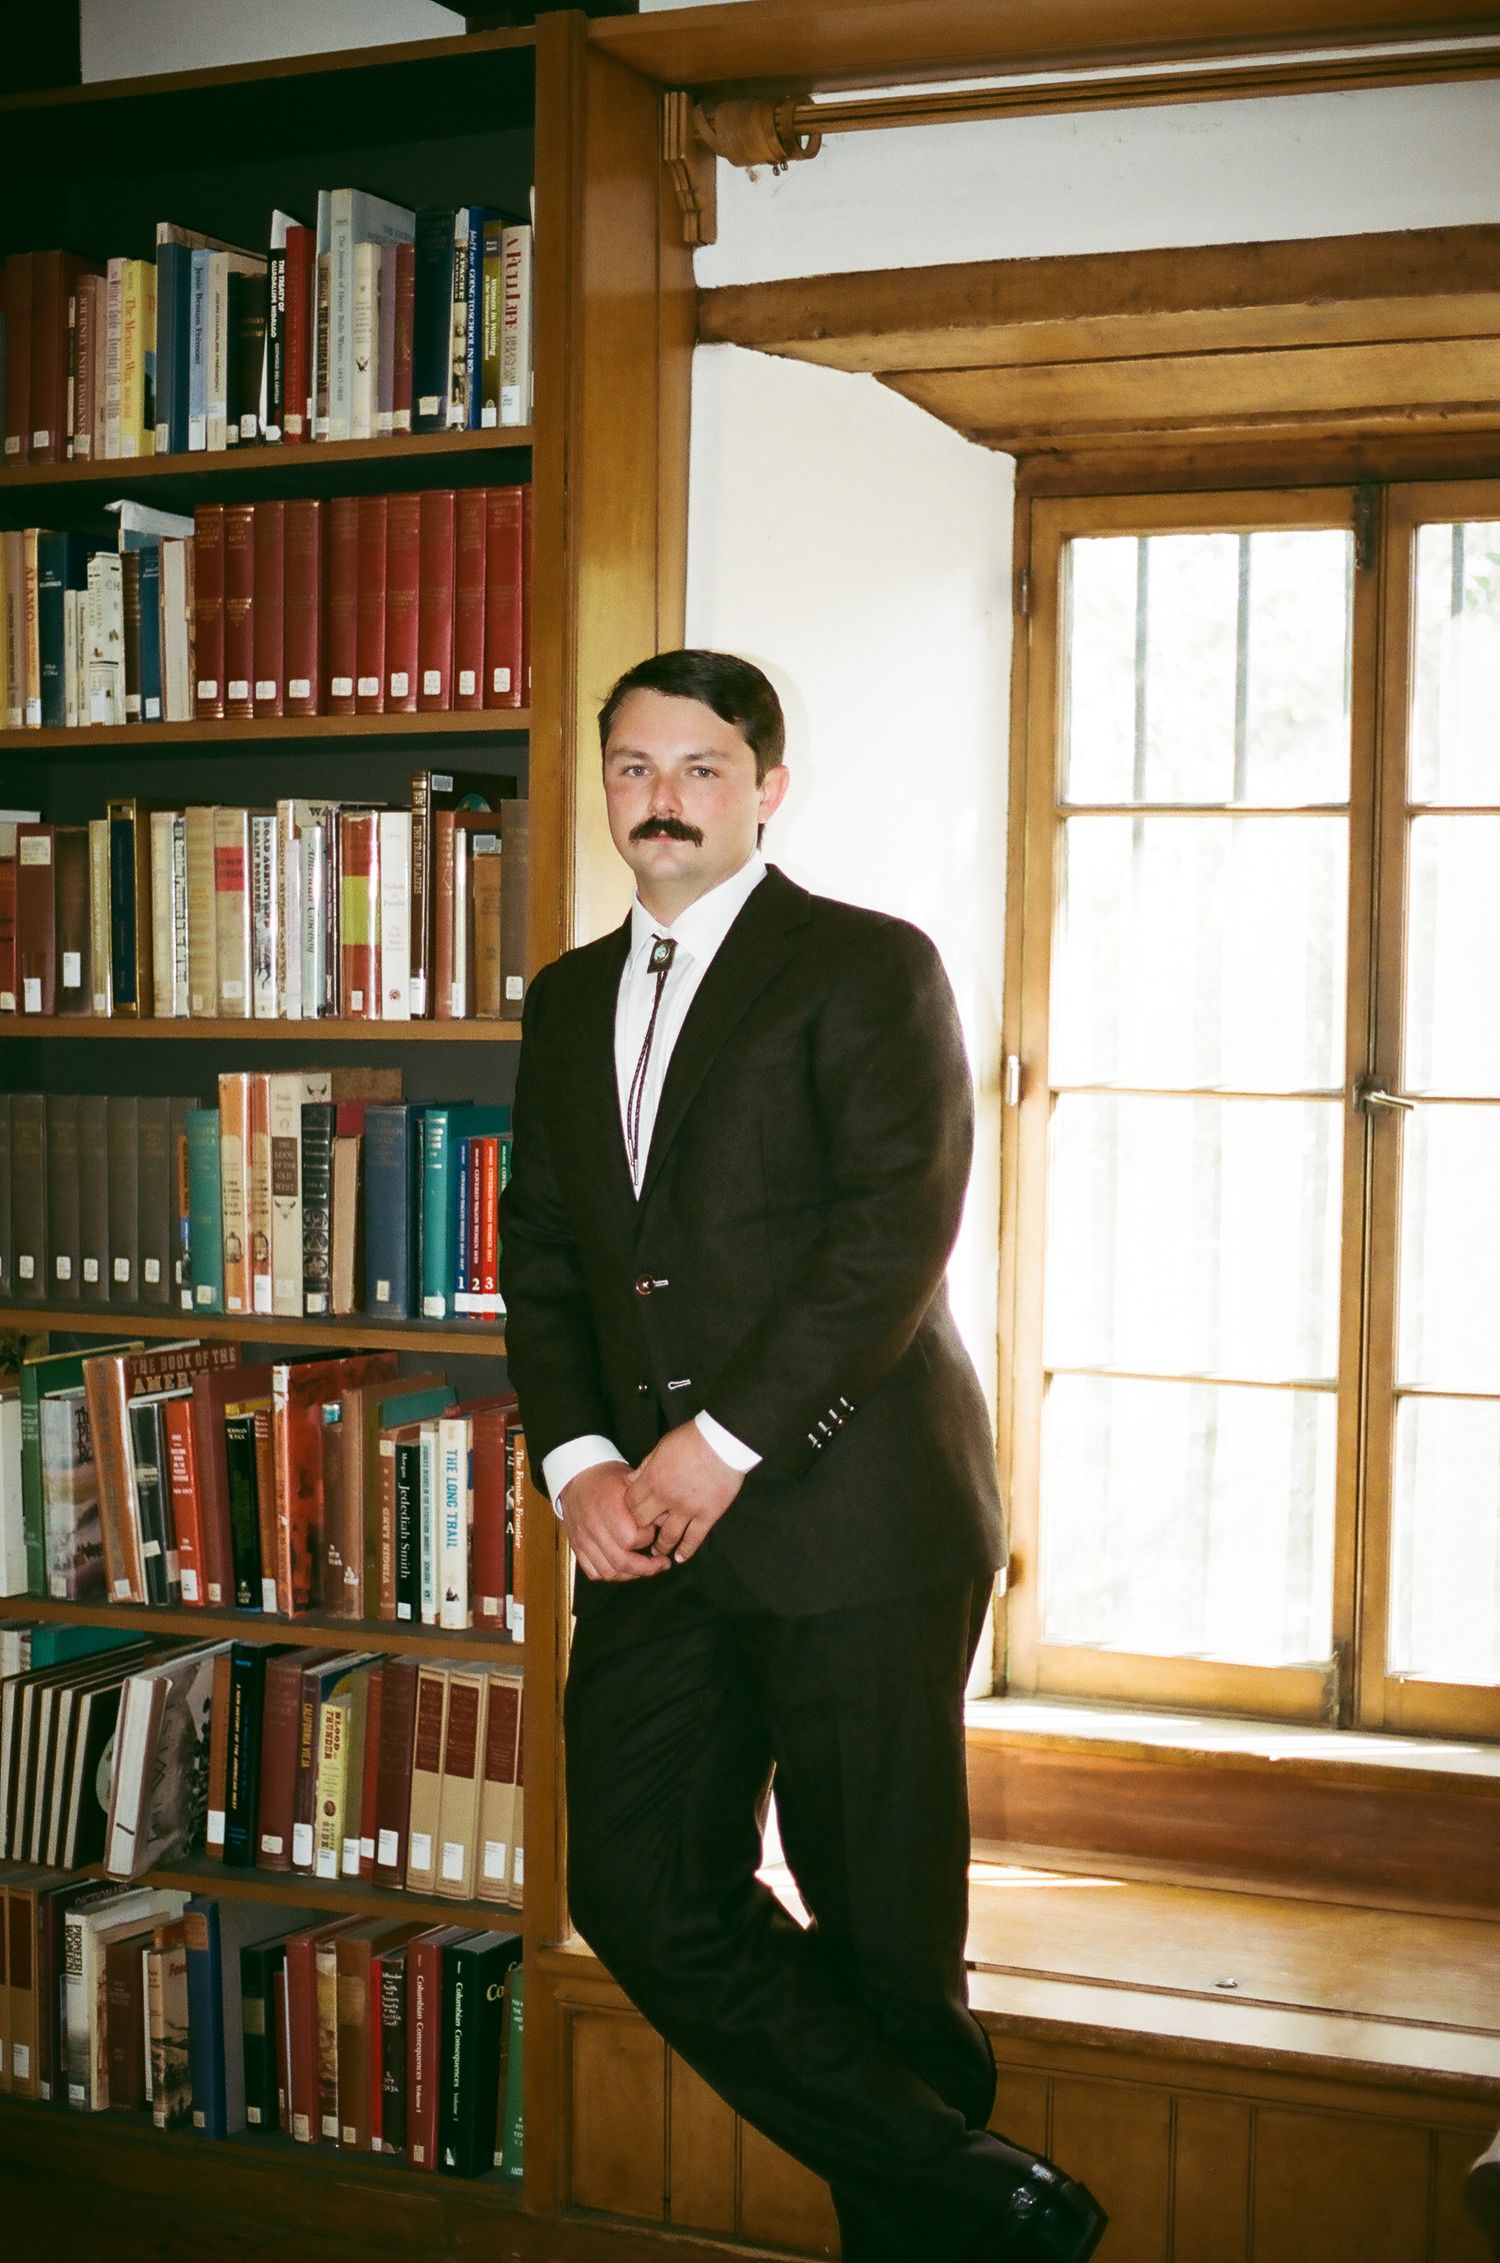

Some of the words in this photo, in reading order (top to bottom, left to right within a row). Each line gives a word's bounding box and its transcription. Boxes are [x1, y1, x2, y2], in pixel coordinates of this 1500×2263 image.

[507, 236, 518, 247] A
[195, 267, 203, 290] Jessie
[126, 298, 135, 316] The
[278, 302, 284, 312] OF
[491, 312, 497, 320] in
[125, 320, 135, 359] Mexican
[489, 322, 497, 356] Waiting
[79, 352, 87, 378] INTO
[25, 566, 34, 622] ALAMO
[413, 825, 422, 841] THE
[307, 843, 316, 902] American
[305, 907, 316, 954] Cowboy
[458, 1276, 464, 1290] 1
[472, 1278, 480, 1291] 2
[484, 1276, 494, 1290] 3
[132, 1358, 155, 1375] THE
[161, 1353, 192, 1371] BOOK
[195, 1350, 209, 1369] OF
[211, 1347, 236, 1364] THE
[446, 1450, 458, 1472] THE
[516, 1449, 524, 1468] The
[446, 1477, 458, 1507] LONG
[515, 1471, 524, 1506] Female
[382, 1507, 391, 1539] LAND
[398, 1483, 410, 1539] Jedediah
[514, 1507, 523, 1548] Frontier
[446, 1513, 458, 1549] TRAIL
[382, 1543, 391, 1584] VIRGIN
[400, 1543, 410, 1579] Smith
[234, 1733, 240, 1743] OF
[302, 1703, 313, 1745] CALIFORNIA
[324, 1710, 333, 1759] THUNDER
[301, 1747, 311, 1768] VIEJA
[65, 1925, 73, 1970] WOMEN
[73, 1925, 82, 1972] PIONEER
[416, 1975, 424, 2019] Columbian
[455, 1982, 463, 2027] Columbian
[415, 2022, 423, 2080] Consequences
[453, 2029, 462, 2087] Consequences
